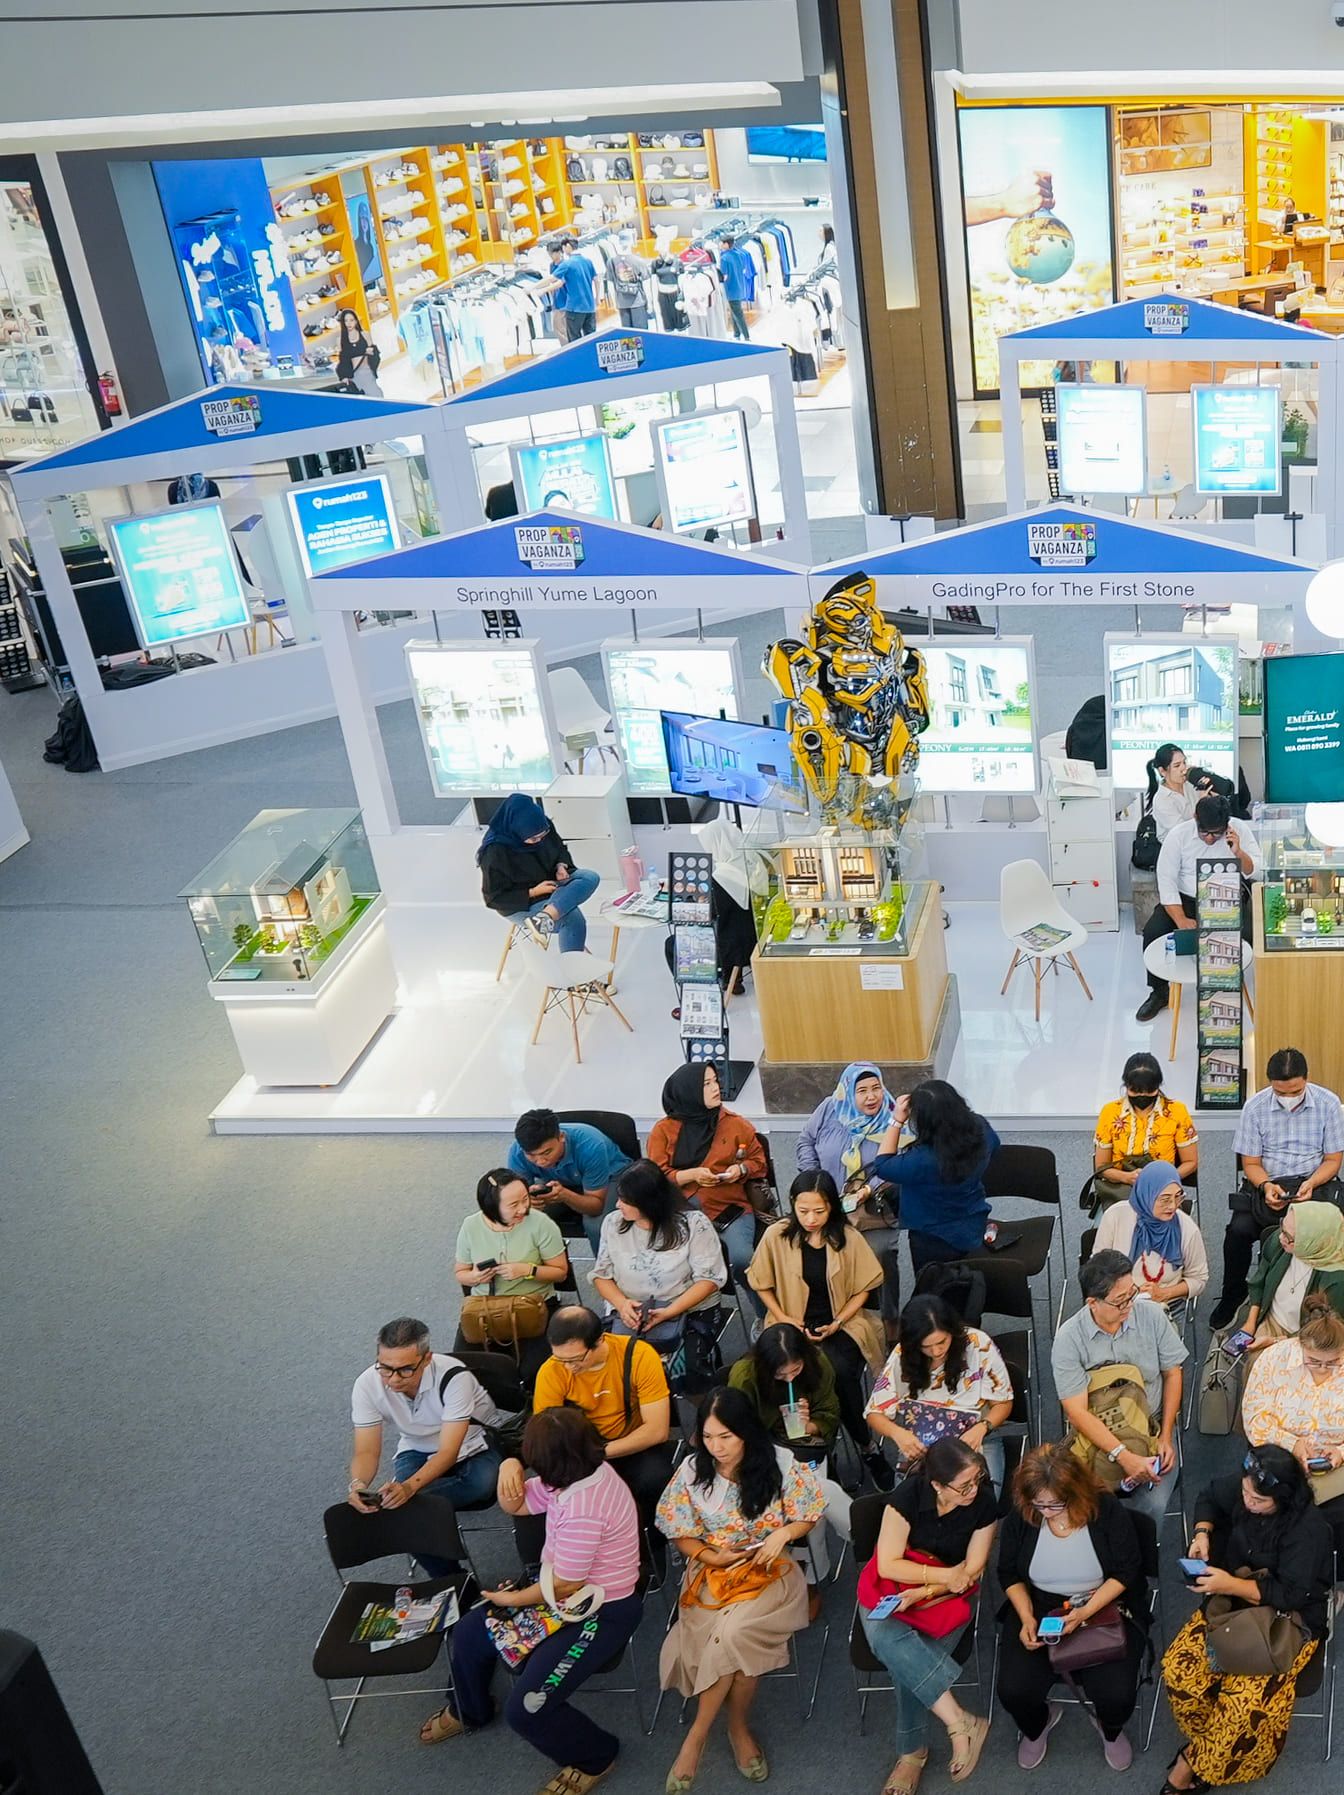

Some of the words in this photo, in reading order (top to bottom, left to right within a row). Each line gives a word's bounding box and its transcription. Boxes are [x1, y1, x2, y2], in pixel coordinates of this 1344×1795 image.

[1146, 305, 1166, 314] PROP
[1147, 317, 1181, 325] VAGANZA
[599, 342, 619, 352] PROP
[601, 351, 636, 364] VAGANZA
[204, 402, 229, 414] PROP
[208, 413, 251, 427] VAGANZA
[519, 529, 547, 541] PROP
[1031, 526, 1060, 538] PROP
[522, 546, 572, 557] VAGANZA
[1033, 542, 1084, 554] VAGANZA
[456, 587, 533, 605] Springhill
[538, 587, 587, 601] Yume
[593, 587, 657, 605] Lagoon
[932, 582, 1026, 600] GadingPro
[1032, 582, 1055, 597] for
[1060, 582, 1093, 597] The
[1100, 582, 1138, 597] First
[1144, 582, 1195, 597] Stone
[1287, 711, 1335, 724] EMERALD
[919, 744, 952, 753] PEONY
